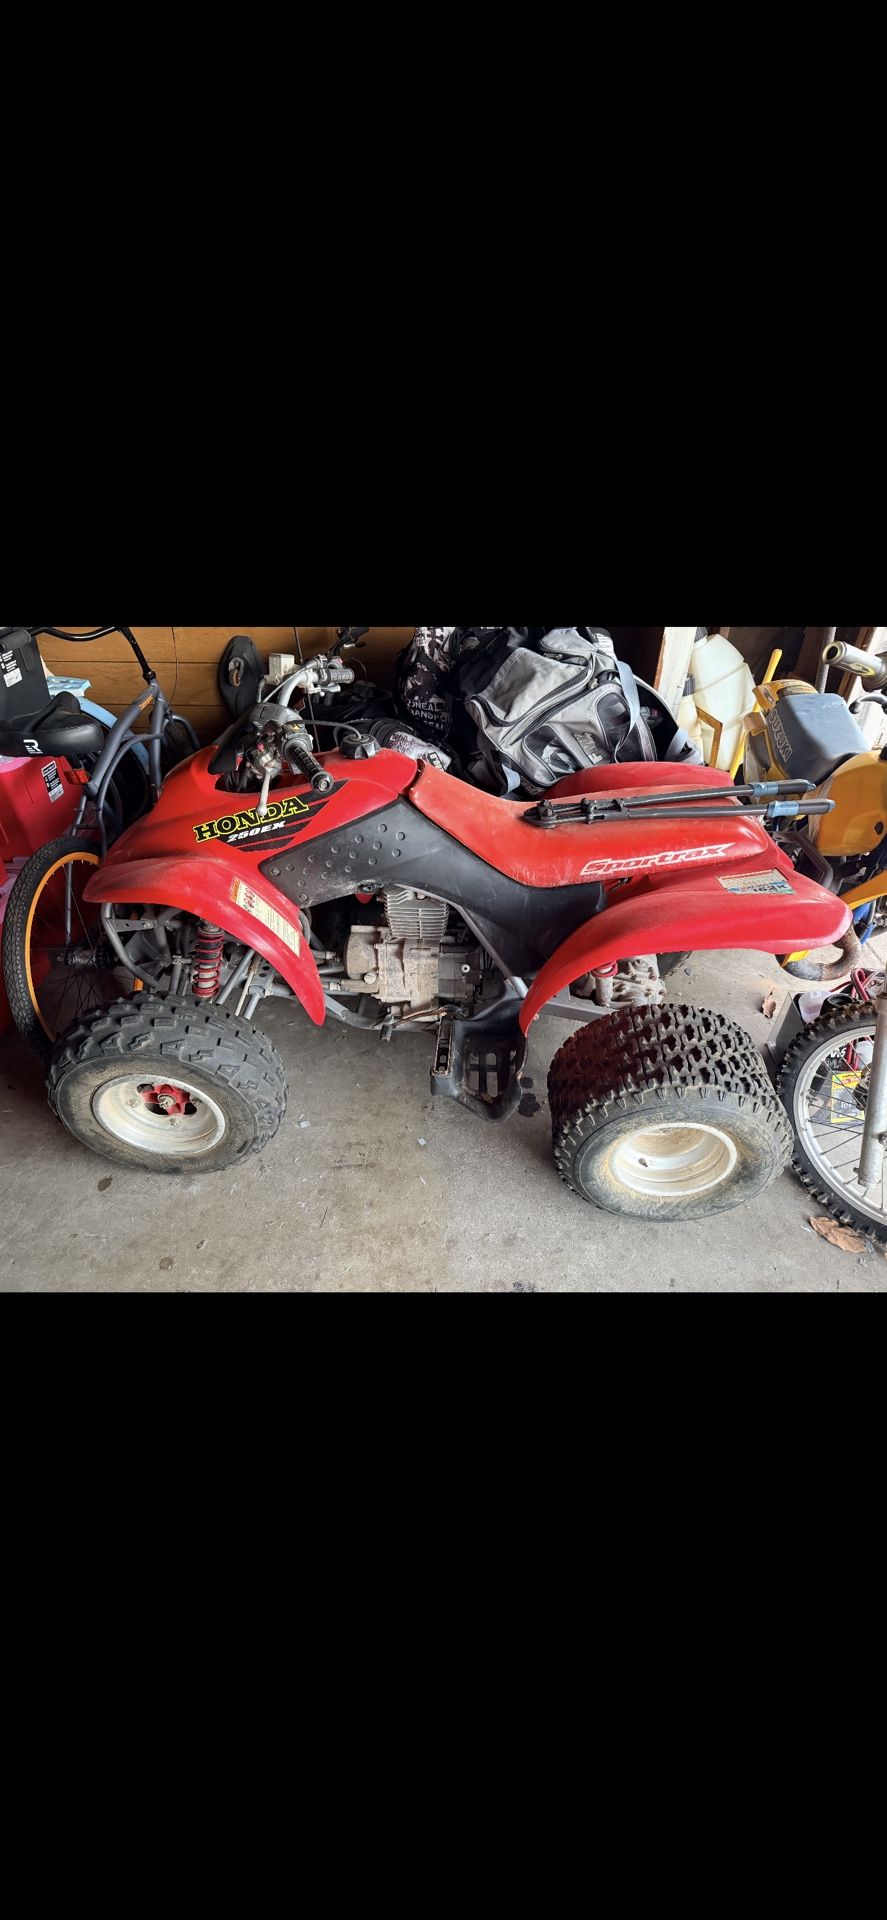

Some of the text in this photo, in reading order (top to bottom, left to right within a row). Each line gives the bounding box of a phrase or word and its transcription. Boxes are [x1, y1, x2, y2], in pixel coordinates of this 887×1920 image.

[768, 709, 793, 763] SUZUKI
[193, 796, 309, 842] HONDA
[227, 821, 286, 842] 250EX
[580, 842, 736, 876] Sportrax
